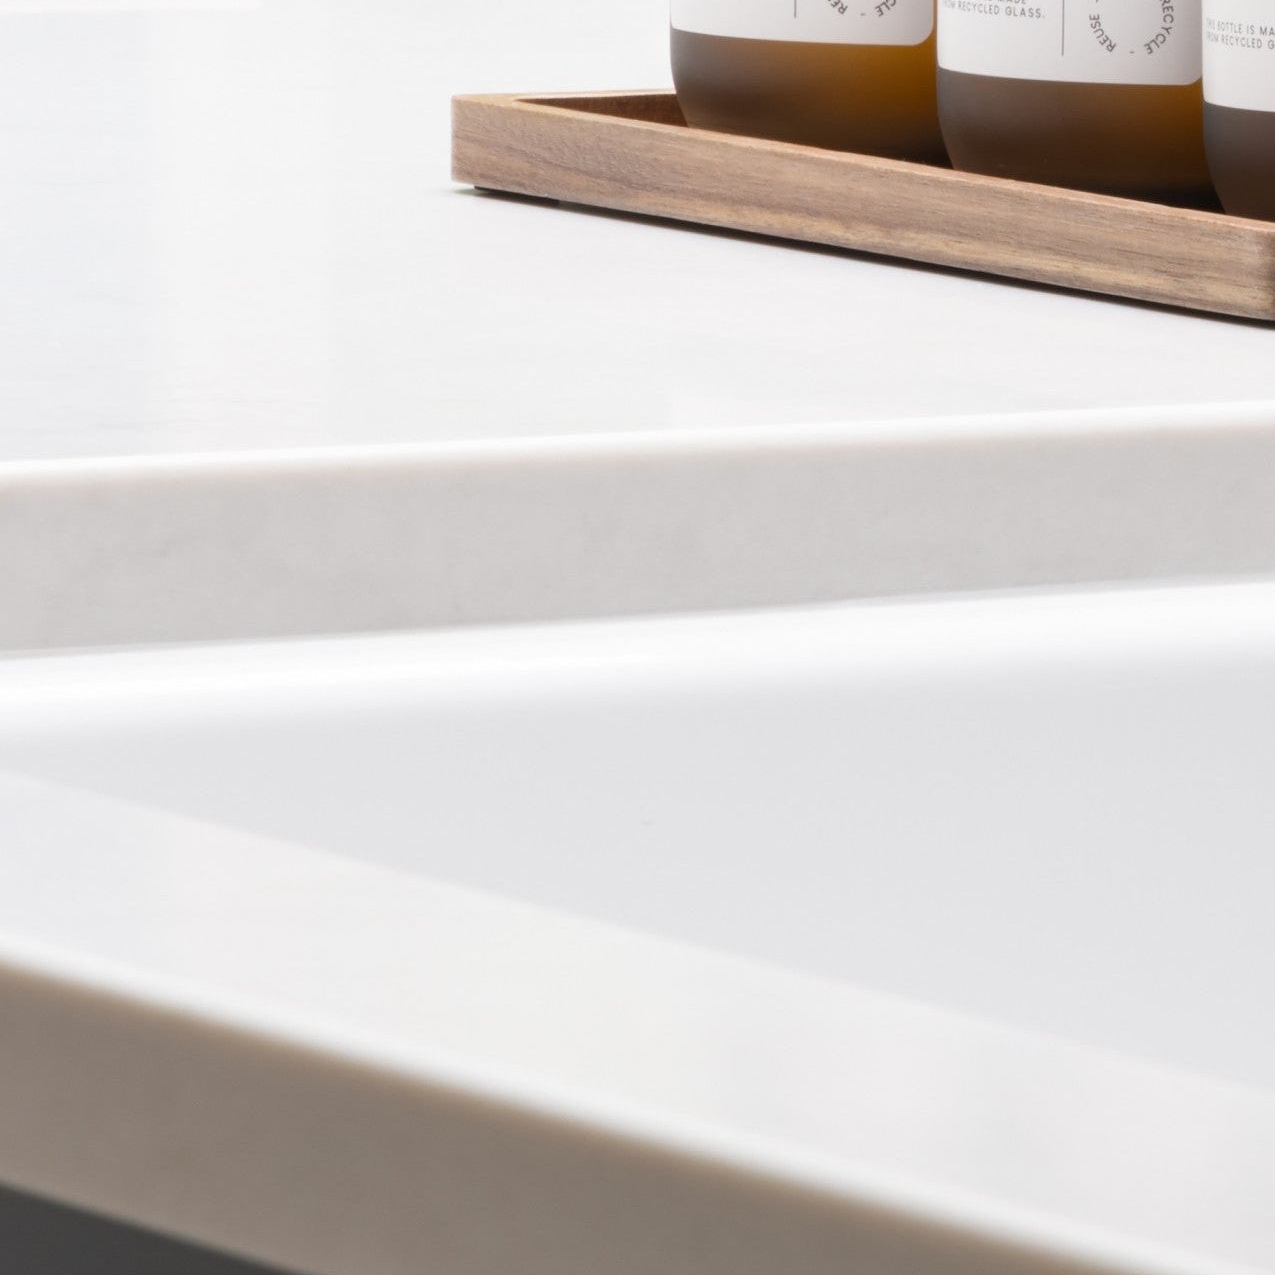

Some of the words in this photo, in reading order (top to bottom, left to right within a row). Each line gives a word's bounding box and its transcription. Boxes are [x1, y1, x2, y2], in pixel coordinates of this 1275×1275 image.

[958, 0, 1000, 15] RECYCLED
[1004, 6, 1046, 19] GLASS.
[1089, 13, 1117, 53] REUSE
[1217, 20, 1242, 34] BOTTLE
[1246, 25, 1255, 35] IS
[1221, 34, 1263, 49] RECYCLED
